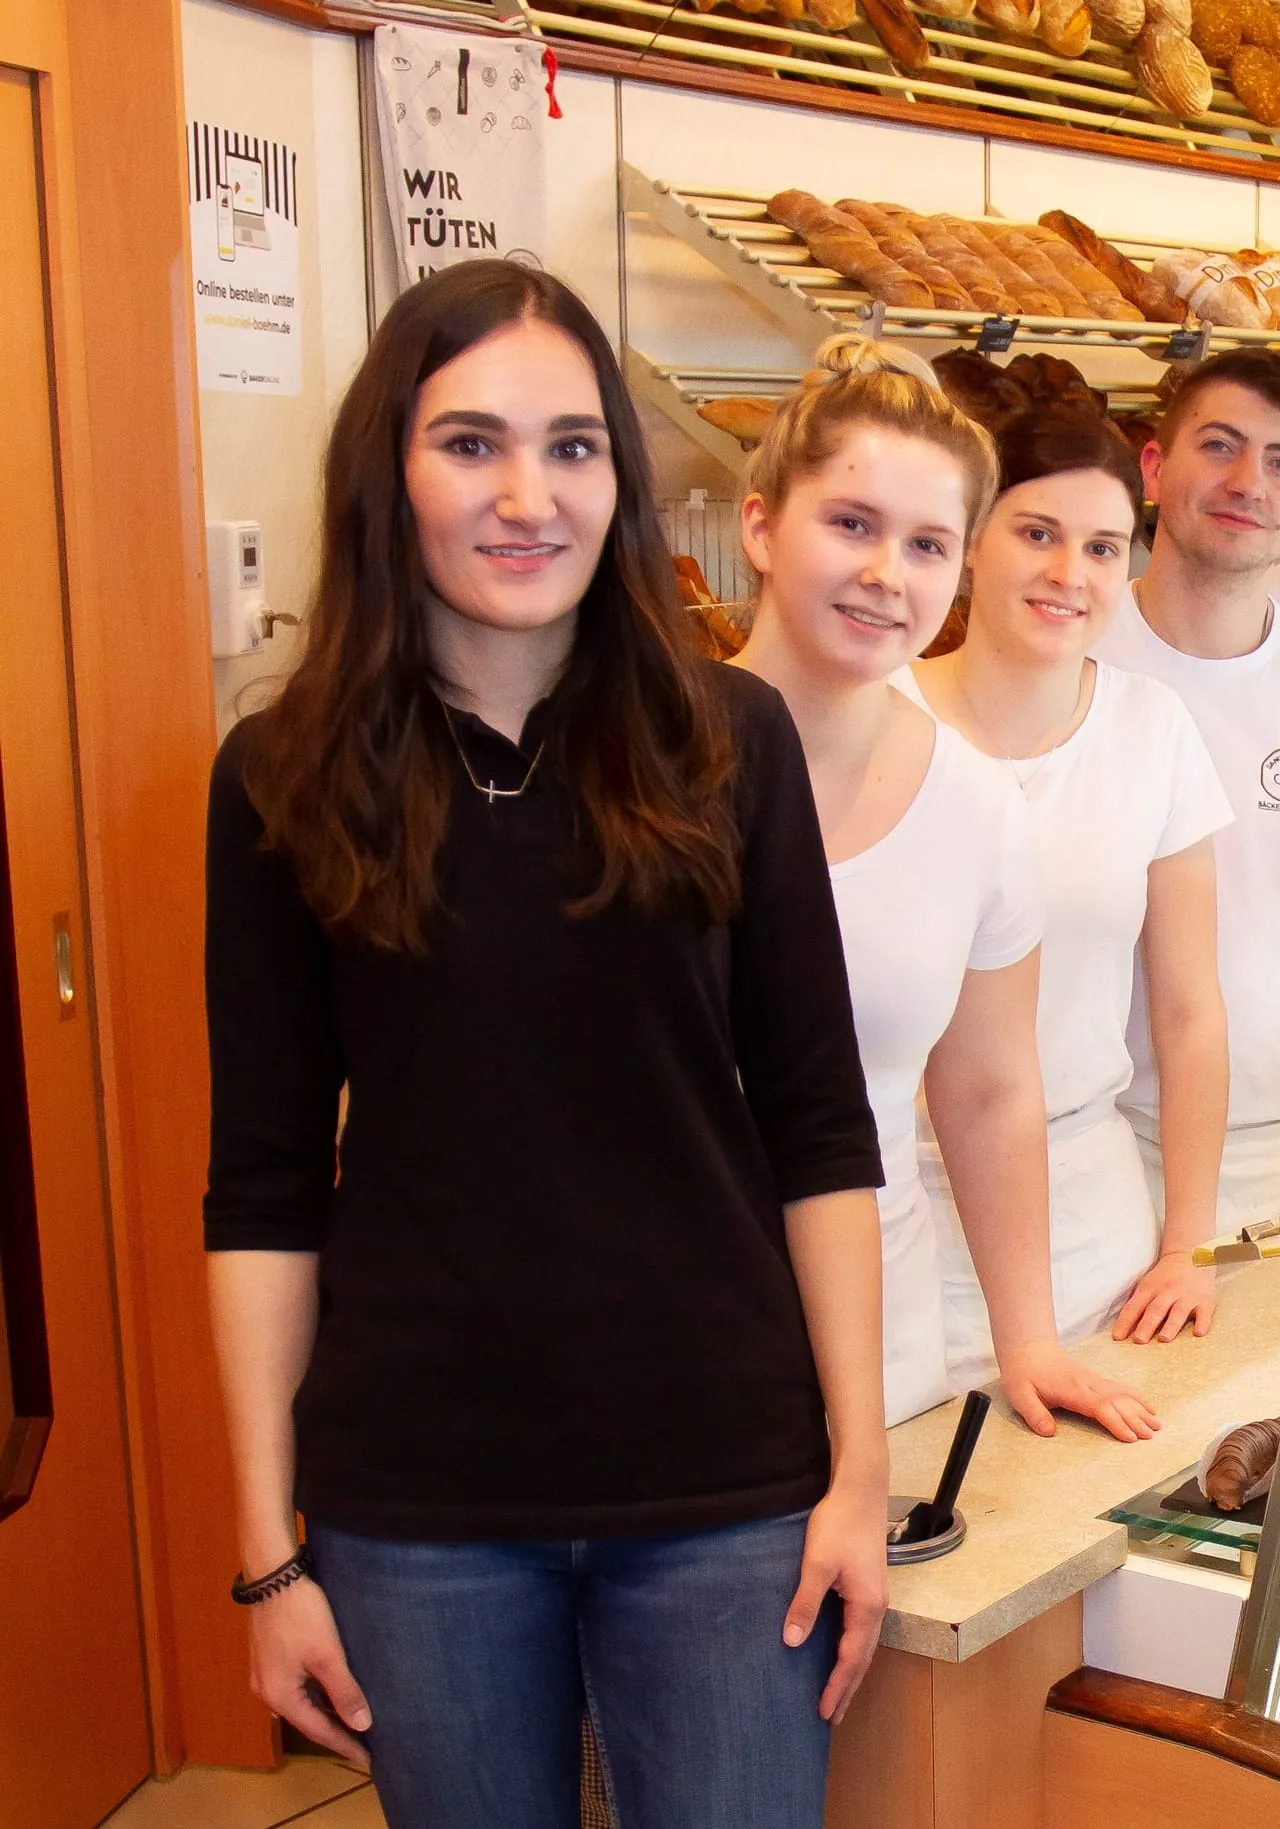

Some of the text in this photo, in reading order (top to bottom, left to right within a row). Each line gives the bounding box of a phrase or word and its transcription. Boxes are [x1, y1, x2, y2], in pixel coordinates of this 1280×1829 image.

[403, 168, 462, 200] WIR
[407, 207, 497, 249] TÜTEN
[197, 280, 295, 308] Online bestellen unter
